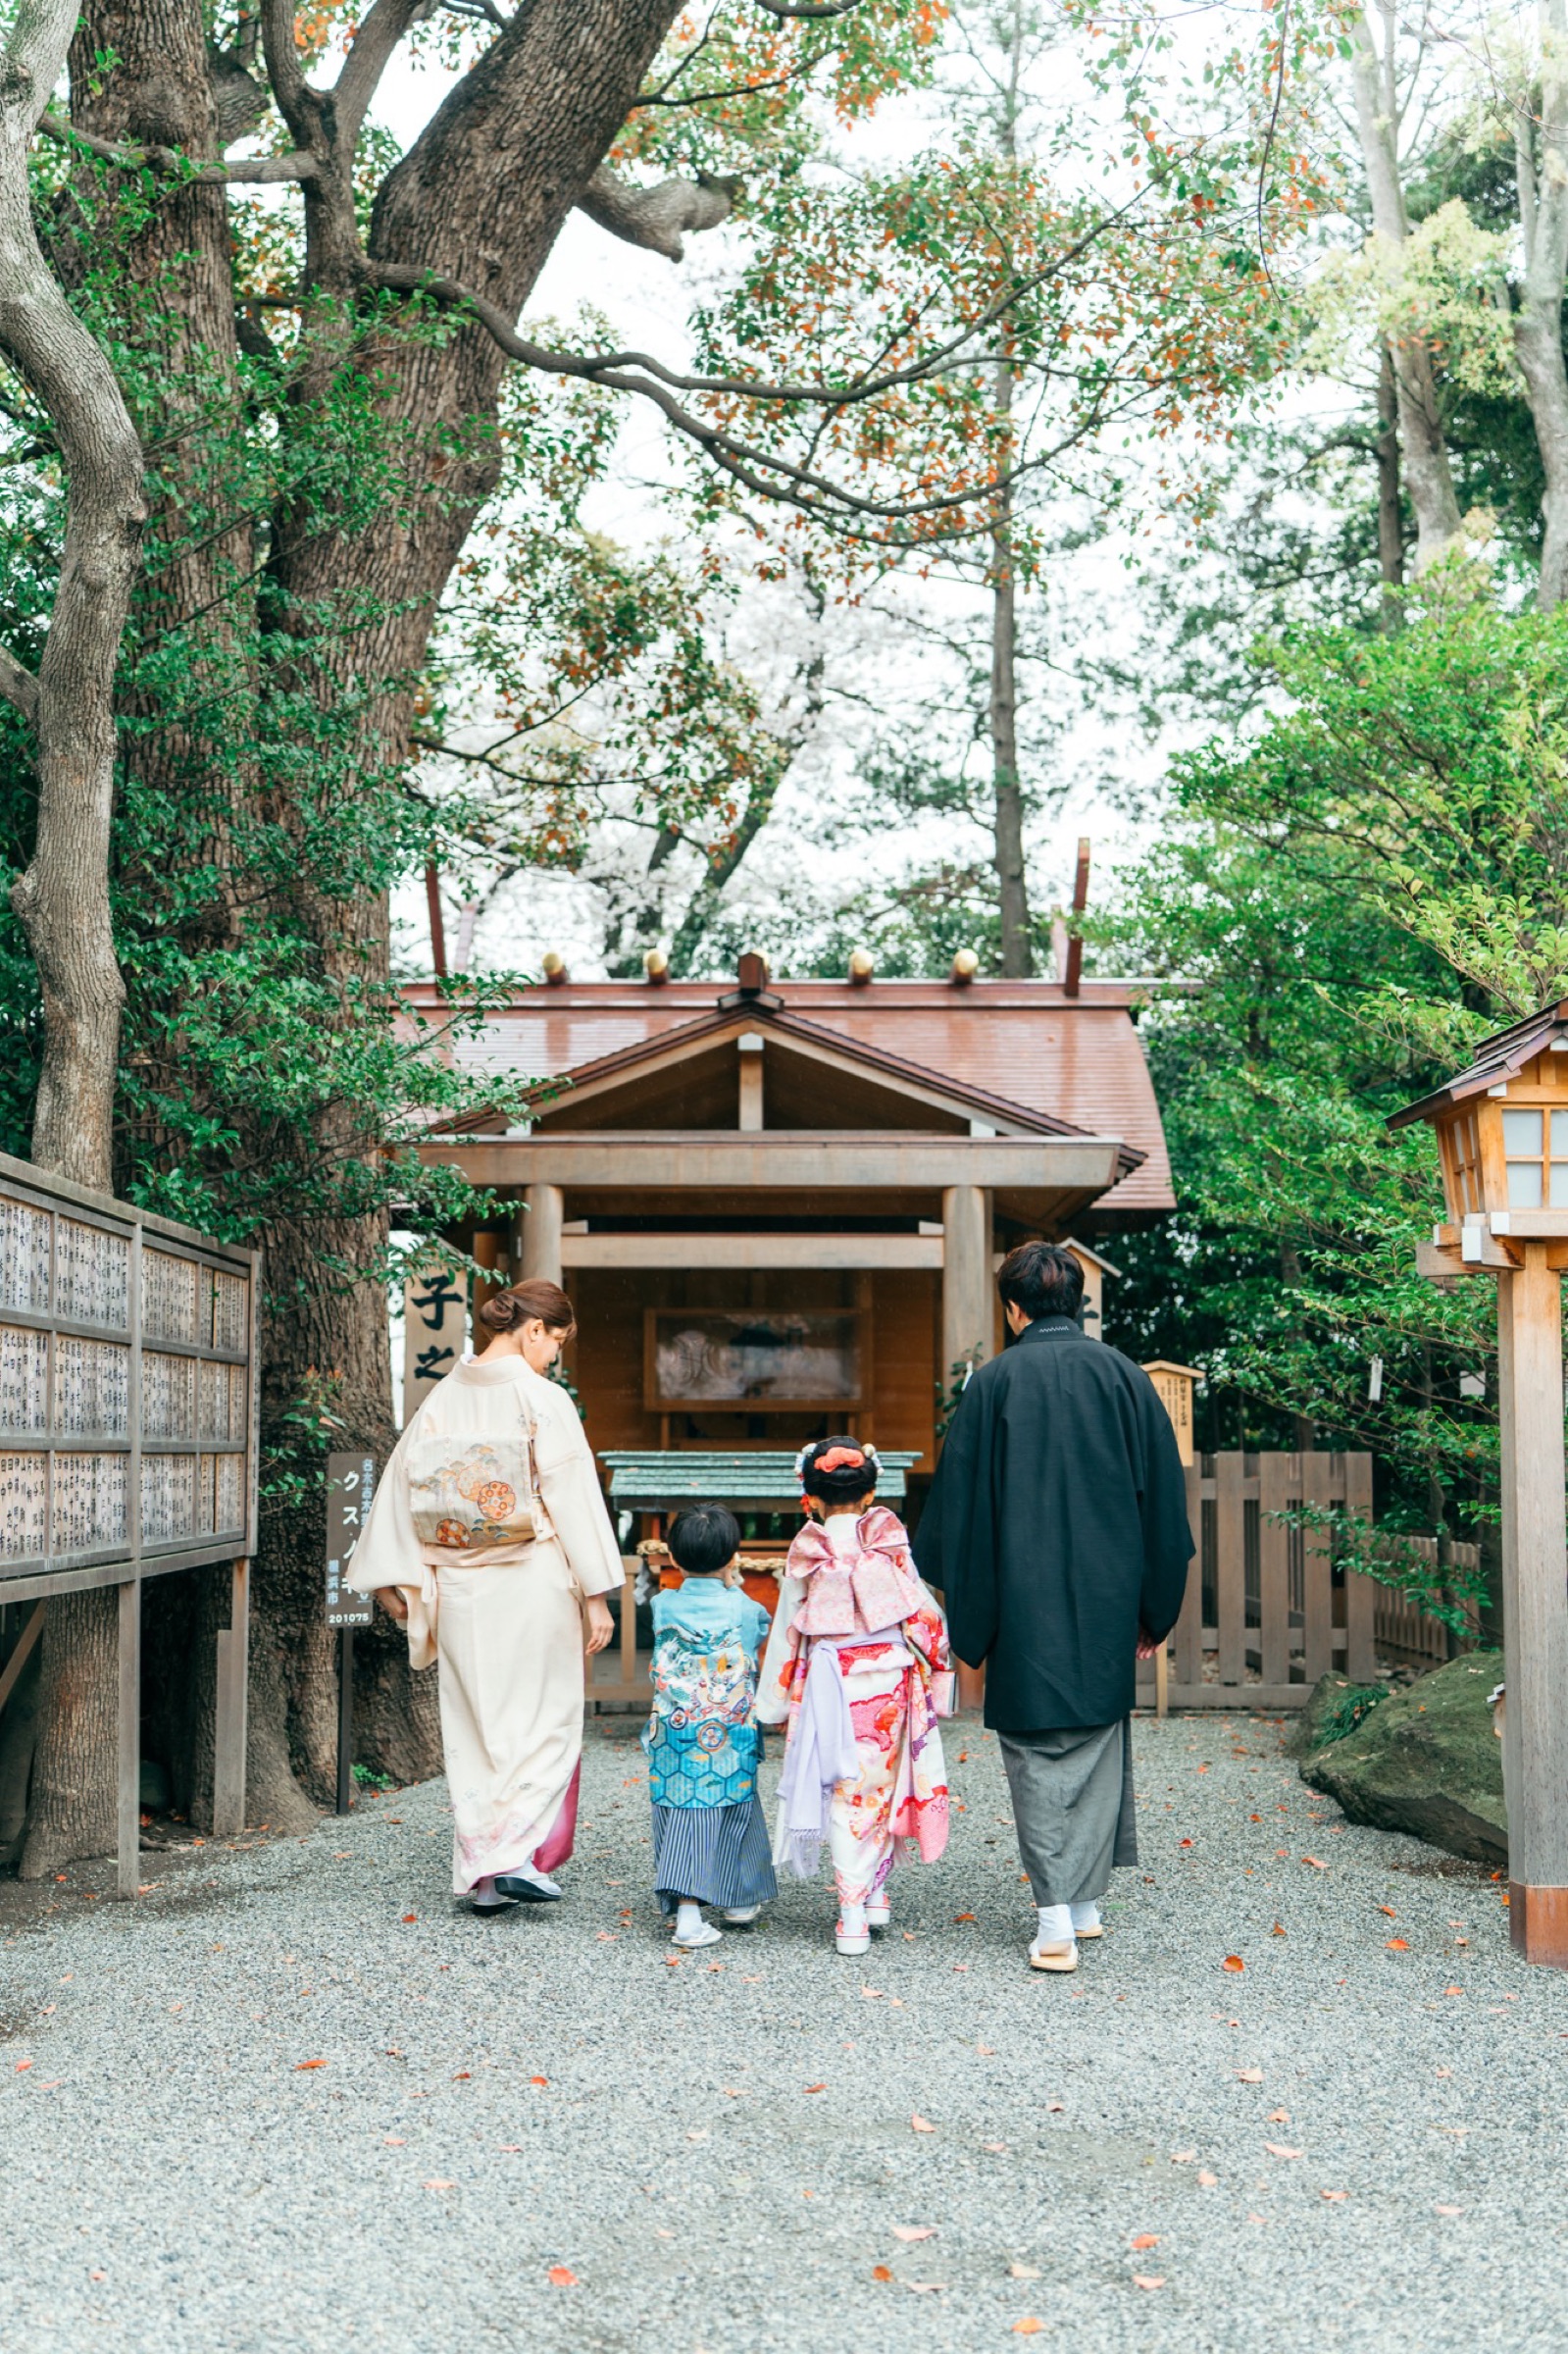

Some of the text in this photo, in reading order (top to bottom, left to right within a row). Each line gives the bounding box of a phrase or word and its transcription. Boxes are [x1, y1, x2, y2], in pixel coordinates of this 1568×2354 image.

[411, 1275, 464, 1380] 子之
[328, 1559, 339, 1606] 横浜市
[329, 1612, 370, 1624] 201075
